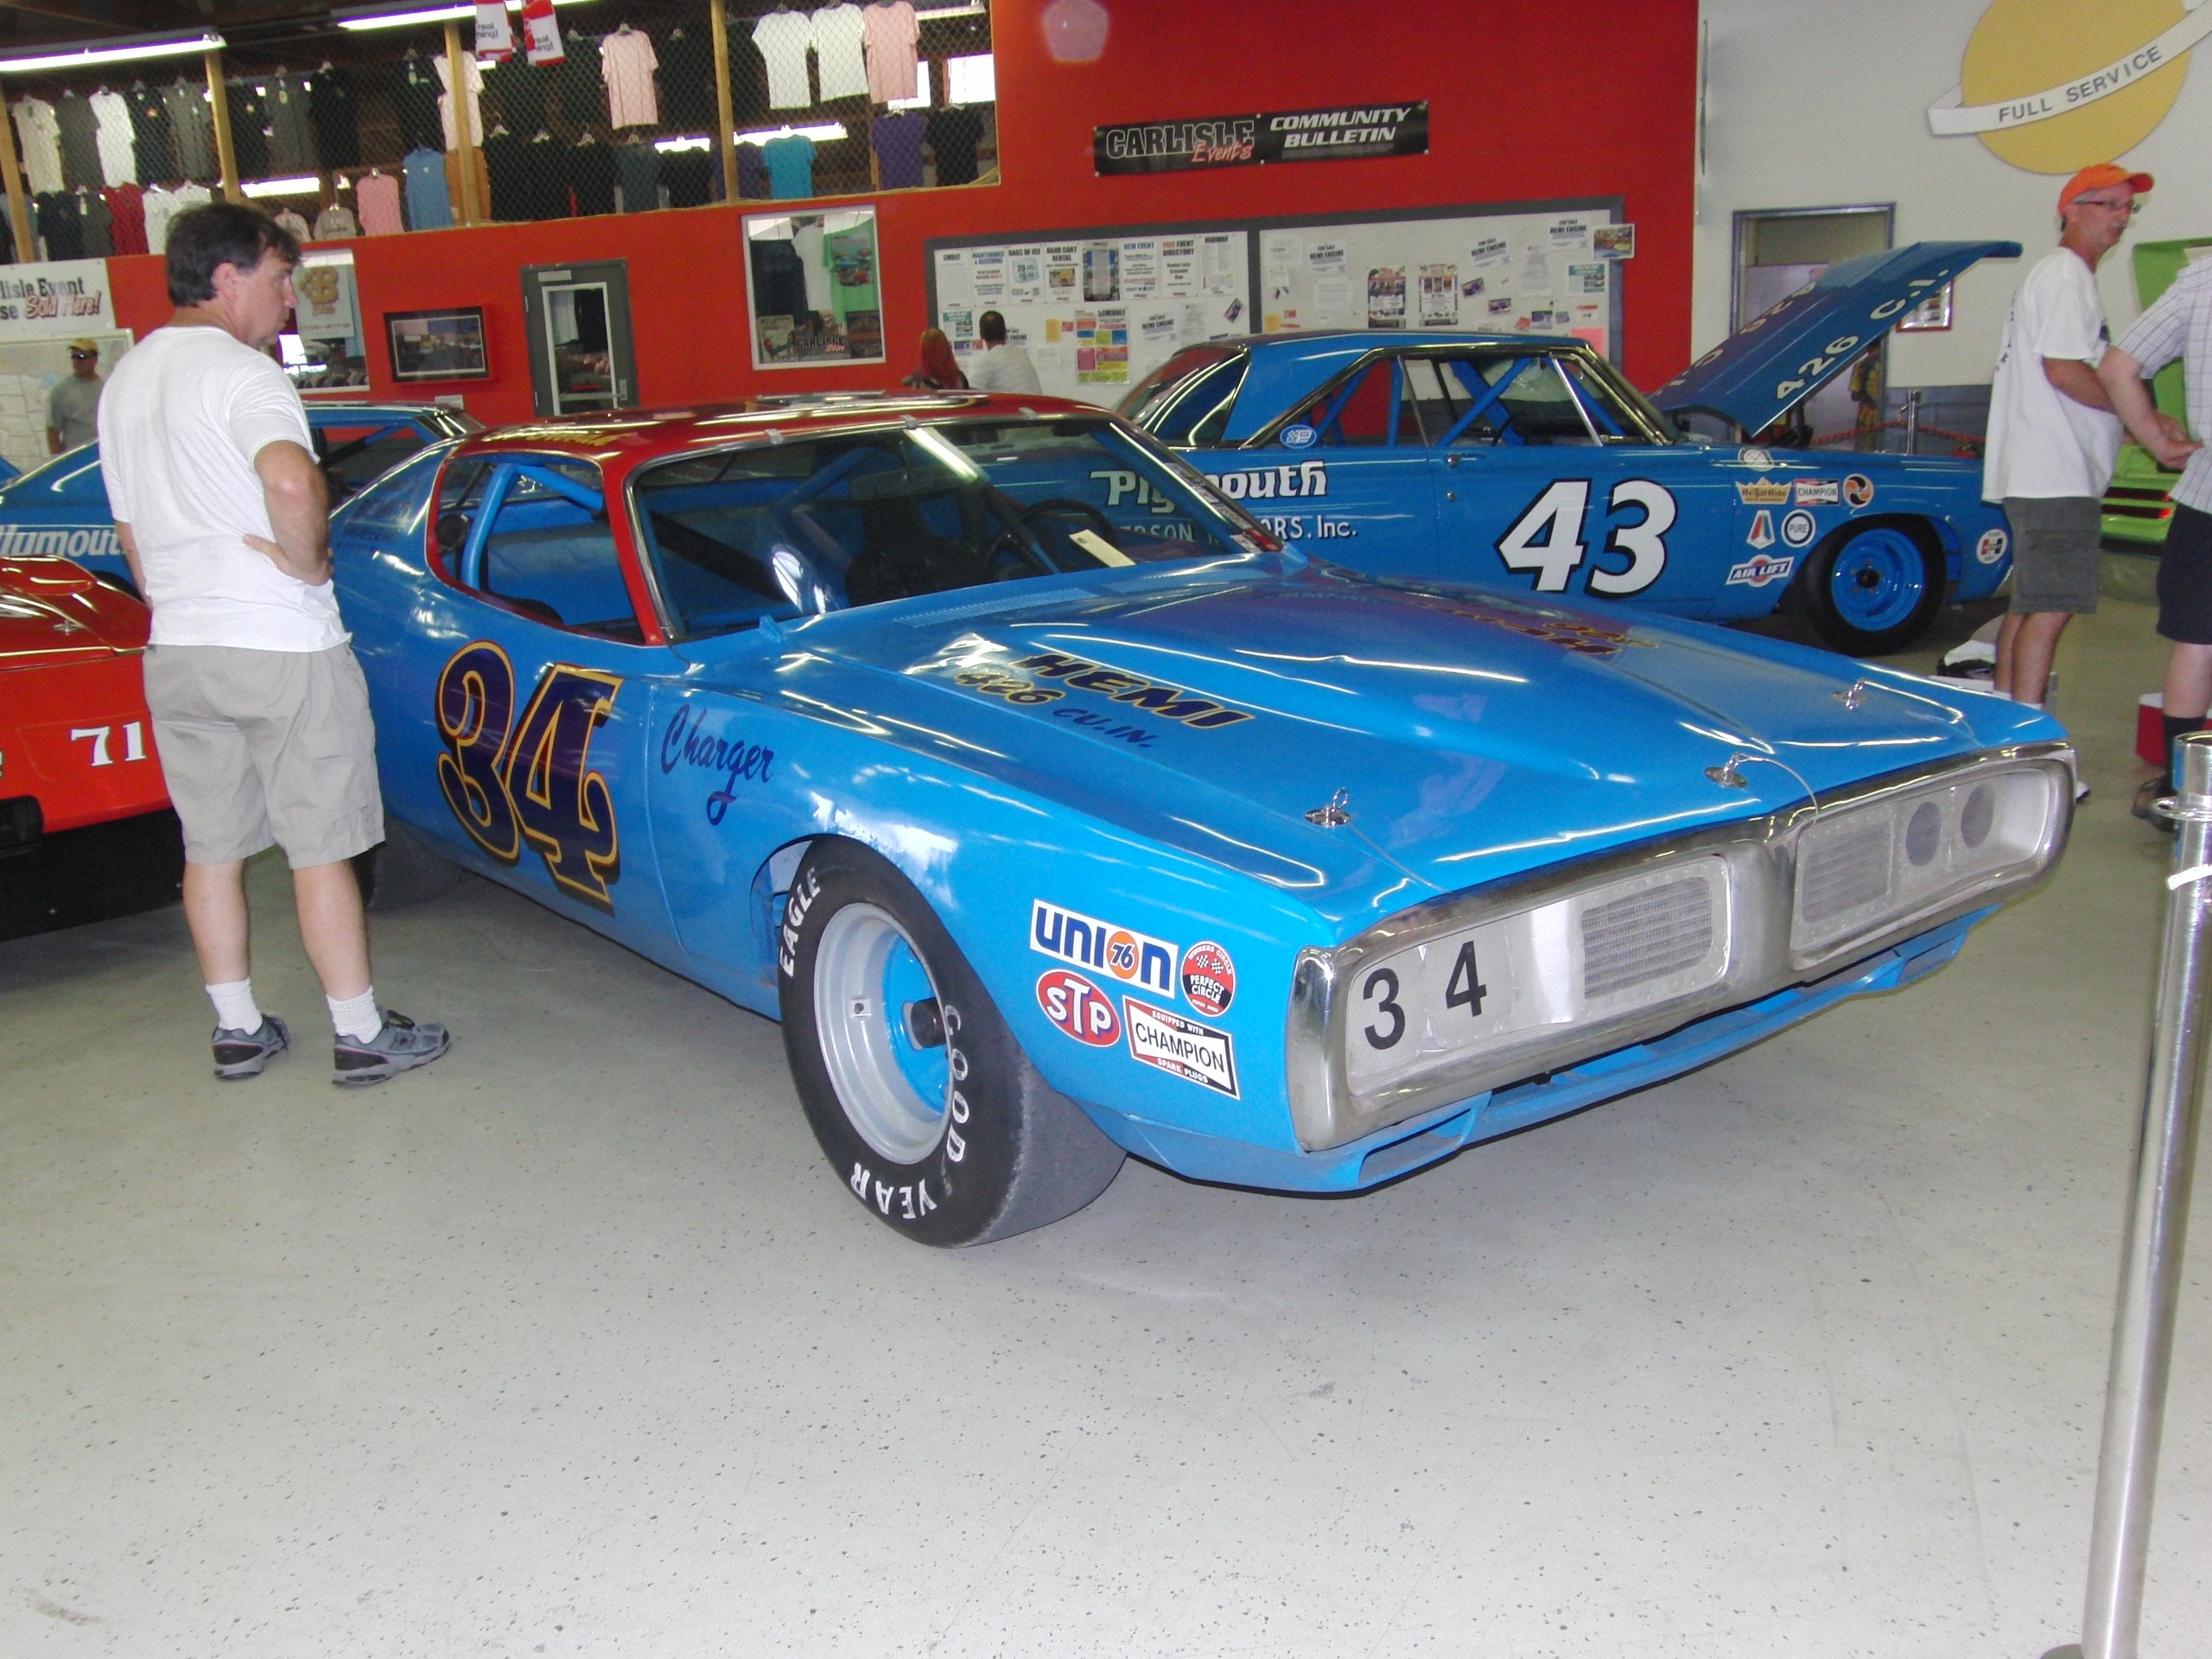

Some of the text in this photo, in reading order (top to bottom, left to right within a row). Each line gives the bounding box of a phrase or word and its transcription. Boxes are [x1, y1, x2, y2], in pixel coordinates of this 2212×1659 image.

[1998, 45, 2164, 123] FULL SERVICE
[1270, 106, 1411, 131] COMMUNITY
[1105, 120, 1255, 159] CARLISLE
[1191, 140, 1253, 163] Events
[1283, 127, 1396, 149] BULLETIN
[1775, 334, 1859, 400] 426
[1742, 487, 1787, 498] Regal Ride
[1797, 486, 1837, 497] CHAMPION
[1317, 513, 1358, 539] Inc.
[1493, 476, 1679, 600] 43
[1789, 523, 1808, 534] PURE
[1732, 563, 1789, 580] AIR LIFT
[954, 671, 1066, 705] 426
[1007, 652, 1256, 730] HEMI
[70, 720, 147, 767] 71
[434, 639, 625, 917] 34
[660, 702, 774, 826] Charger
[779, 867, 823, 978] EAGLE
[1109, 942, 1135, 971] 76
[1187, 944, 1233, 976] WINNERS CIRCLE
[1190, 974, 1225, 995] PERFECT
[1191, 984, 1222, 1004] CIRCLE
[1046, 977, 1113, 1036] STP
[1152, 1010, 1205, 1036] EQUIPPED WITH
[1135, 1022, 1225, 1074] CHAMPION
[1156, 1057, 1209, 1084] SPARK PLUGS
